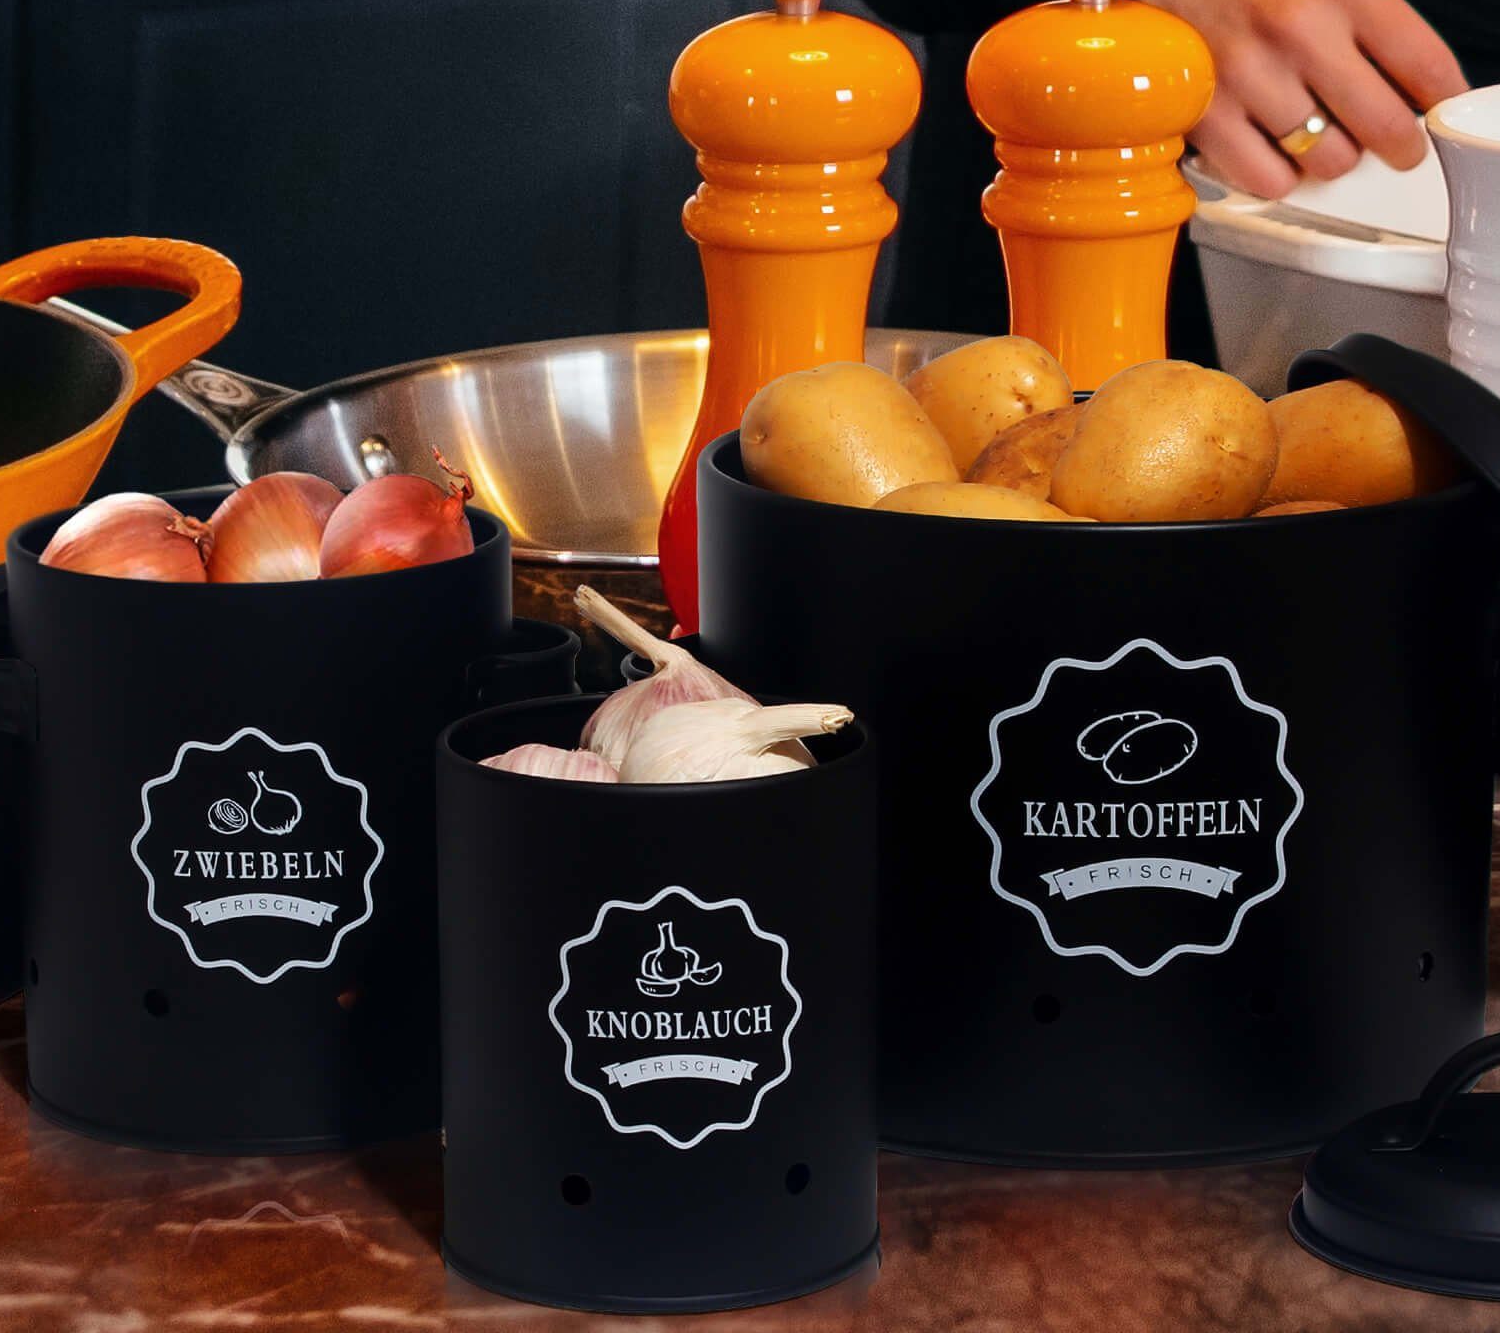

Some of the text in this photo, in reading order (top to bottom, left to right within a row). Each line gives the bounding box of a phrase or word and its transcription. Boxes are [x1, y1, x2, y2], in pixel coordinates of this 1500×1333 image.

[1022, 797, 1263, 839] KARTOFFELN
[173, 849, 345, 880] ZWIEBELN
[1088, 864, 1193, 883] FRISCH
[219, 898, 300, 914] FRISCH
[585, 1004, 773, 1040] KNOBLAUCH
[638, 1060, 721, 1075] FRISCH
